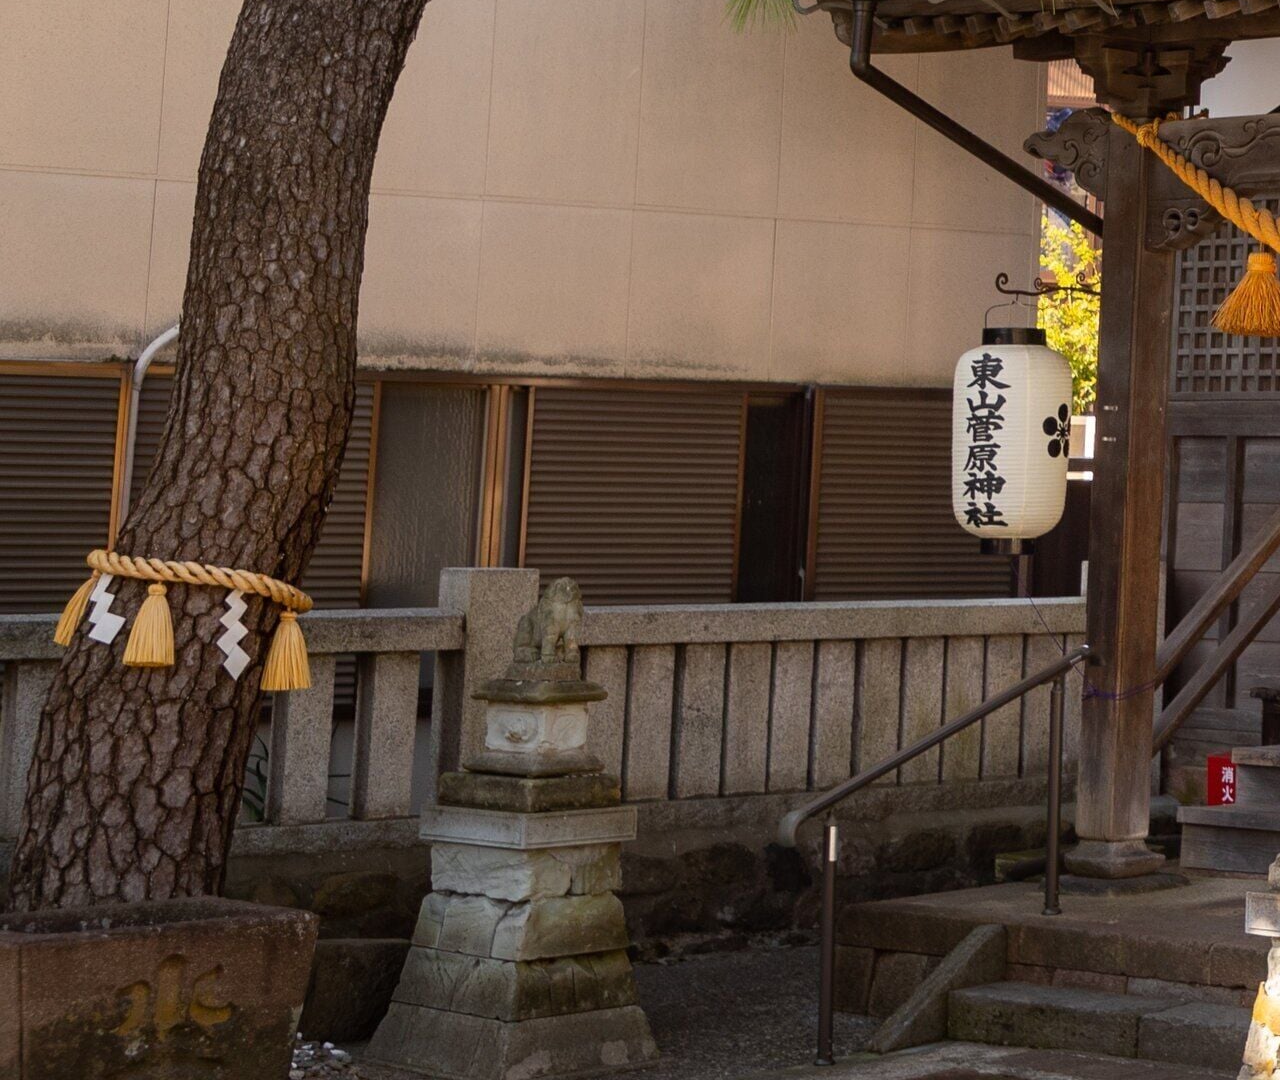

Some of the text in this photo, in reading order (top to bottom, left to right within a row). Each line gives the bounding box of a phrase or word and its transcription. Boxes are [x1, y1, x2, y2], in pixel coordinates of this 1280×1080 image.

[963, 352, 1012, 529] 東山菅原神社
[1221, 766, 1235, 806] 消火
